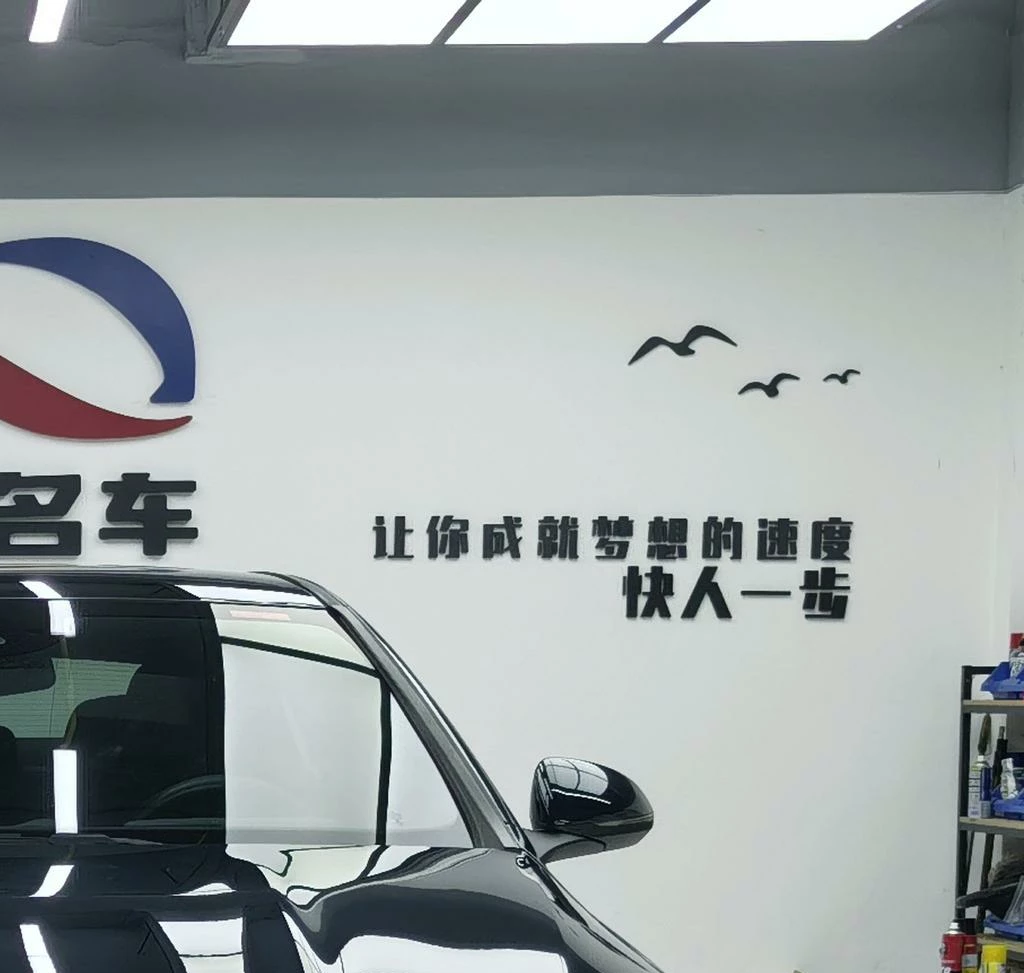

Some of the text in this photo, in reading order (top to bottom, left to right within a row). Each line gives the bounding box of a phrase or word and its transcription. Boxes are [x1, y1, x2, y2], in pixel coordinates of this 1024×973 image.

[372, 515, 854, 562] 让你成就梦想的速度
[622, 565, 851, 620] 快人一步
